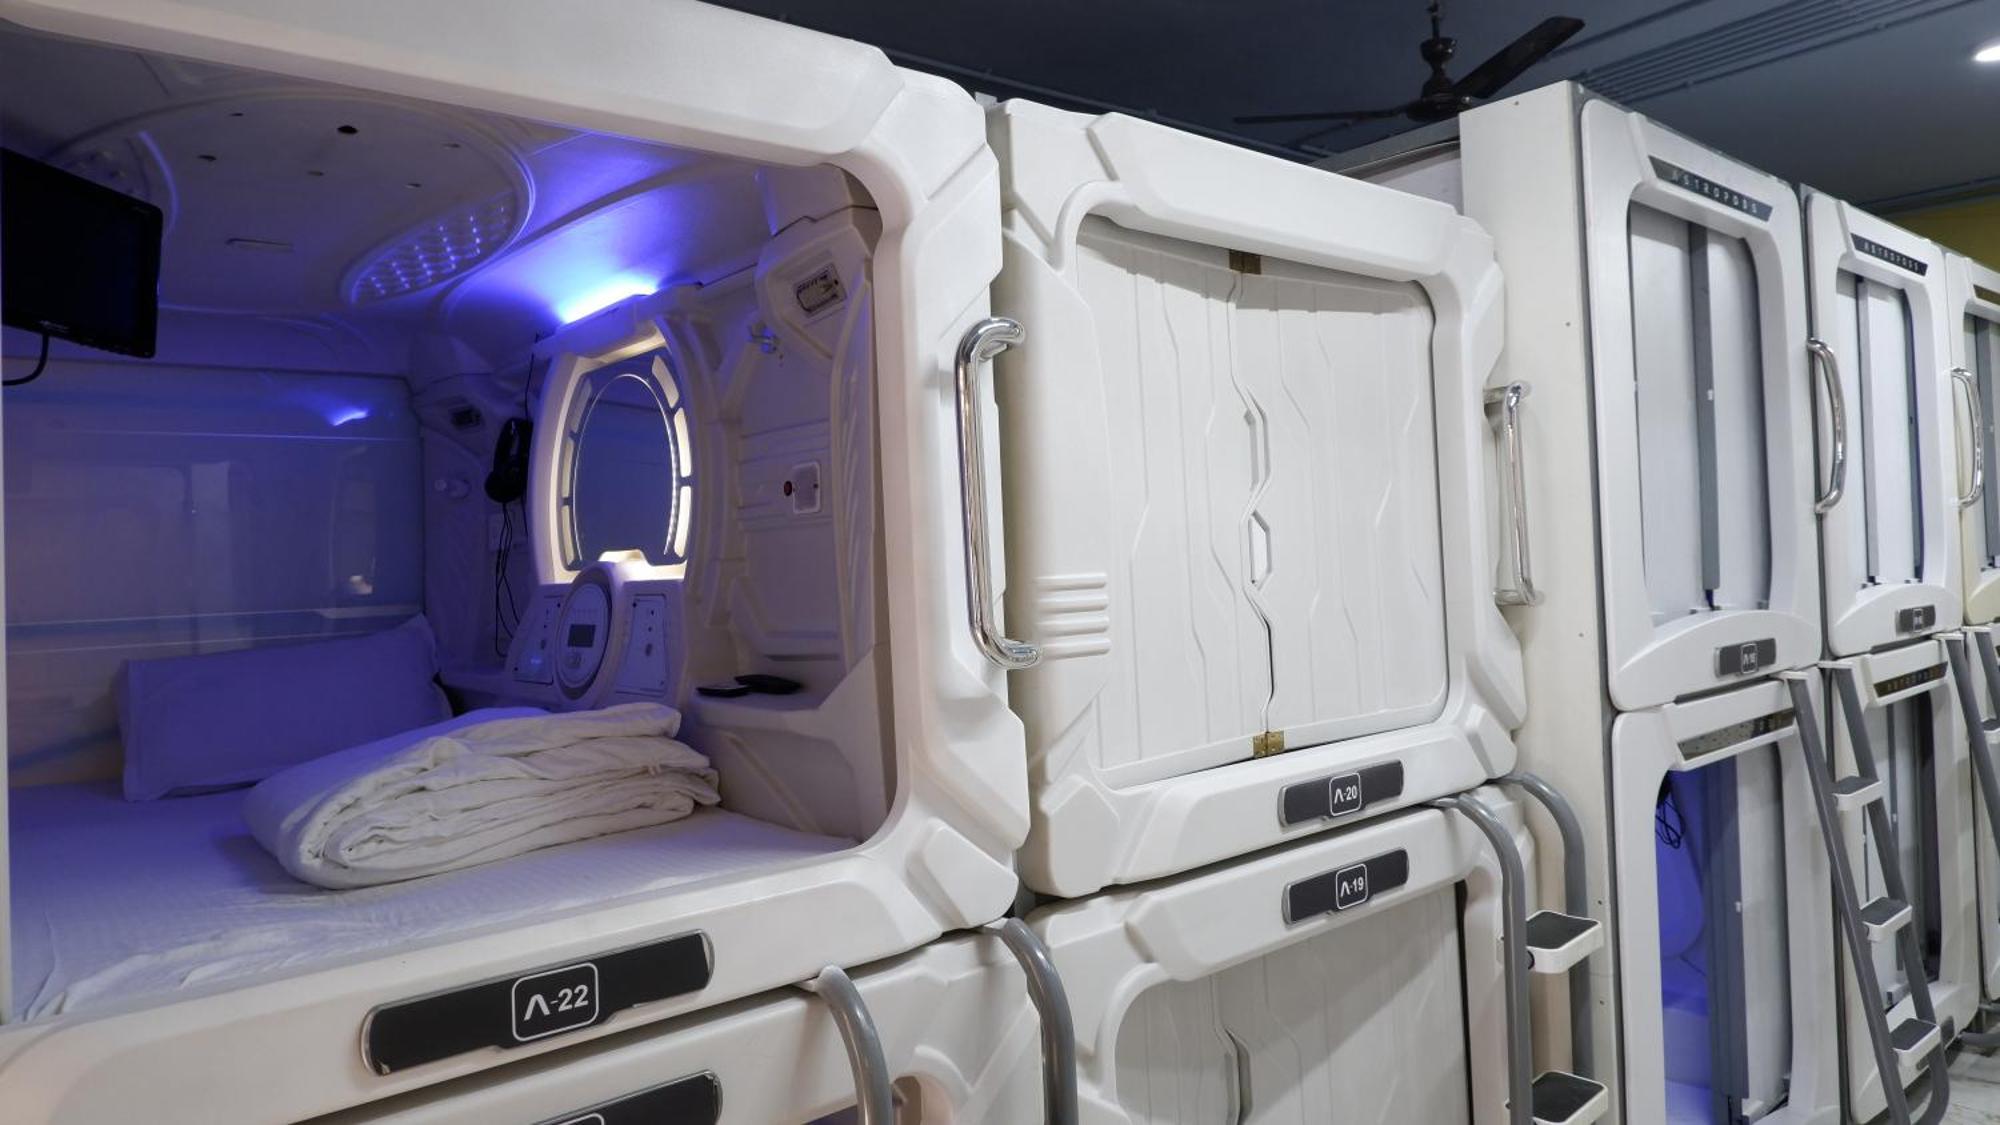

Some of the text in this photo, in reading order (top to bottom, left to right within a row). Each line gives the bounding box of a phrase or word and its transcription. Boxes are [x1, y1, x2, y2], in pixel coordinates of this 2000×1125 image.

[1334, 785, 1358, 805] A-20
[1340, 876, 1364, 898] A-19
[523, 984, 589, 1021] A-22
